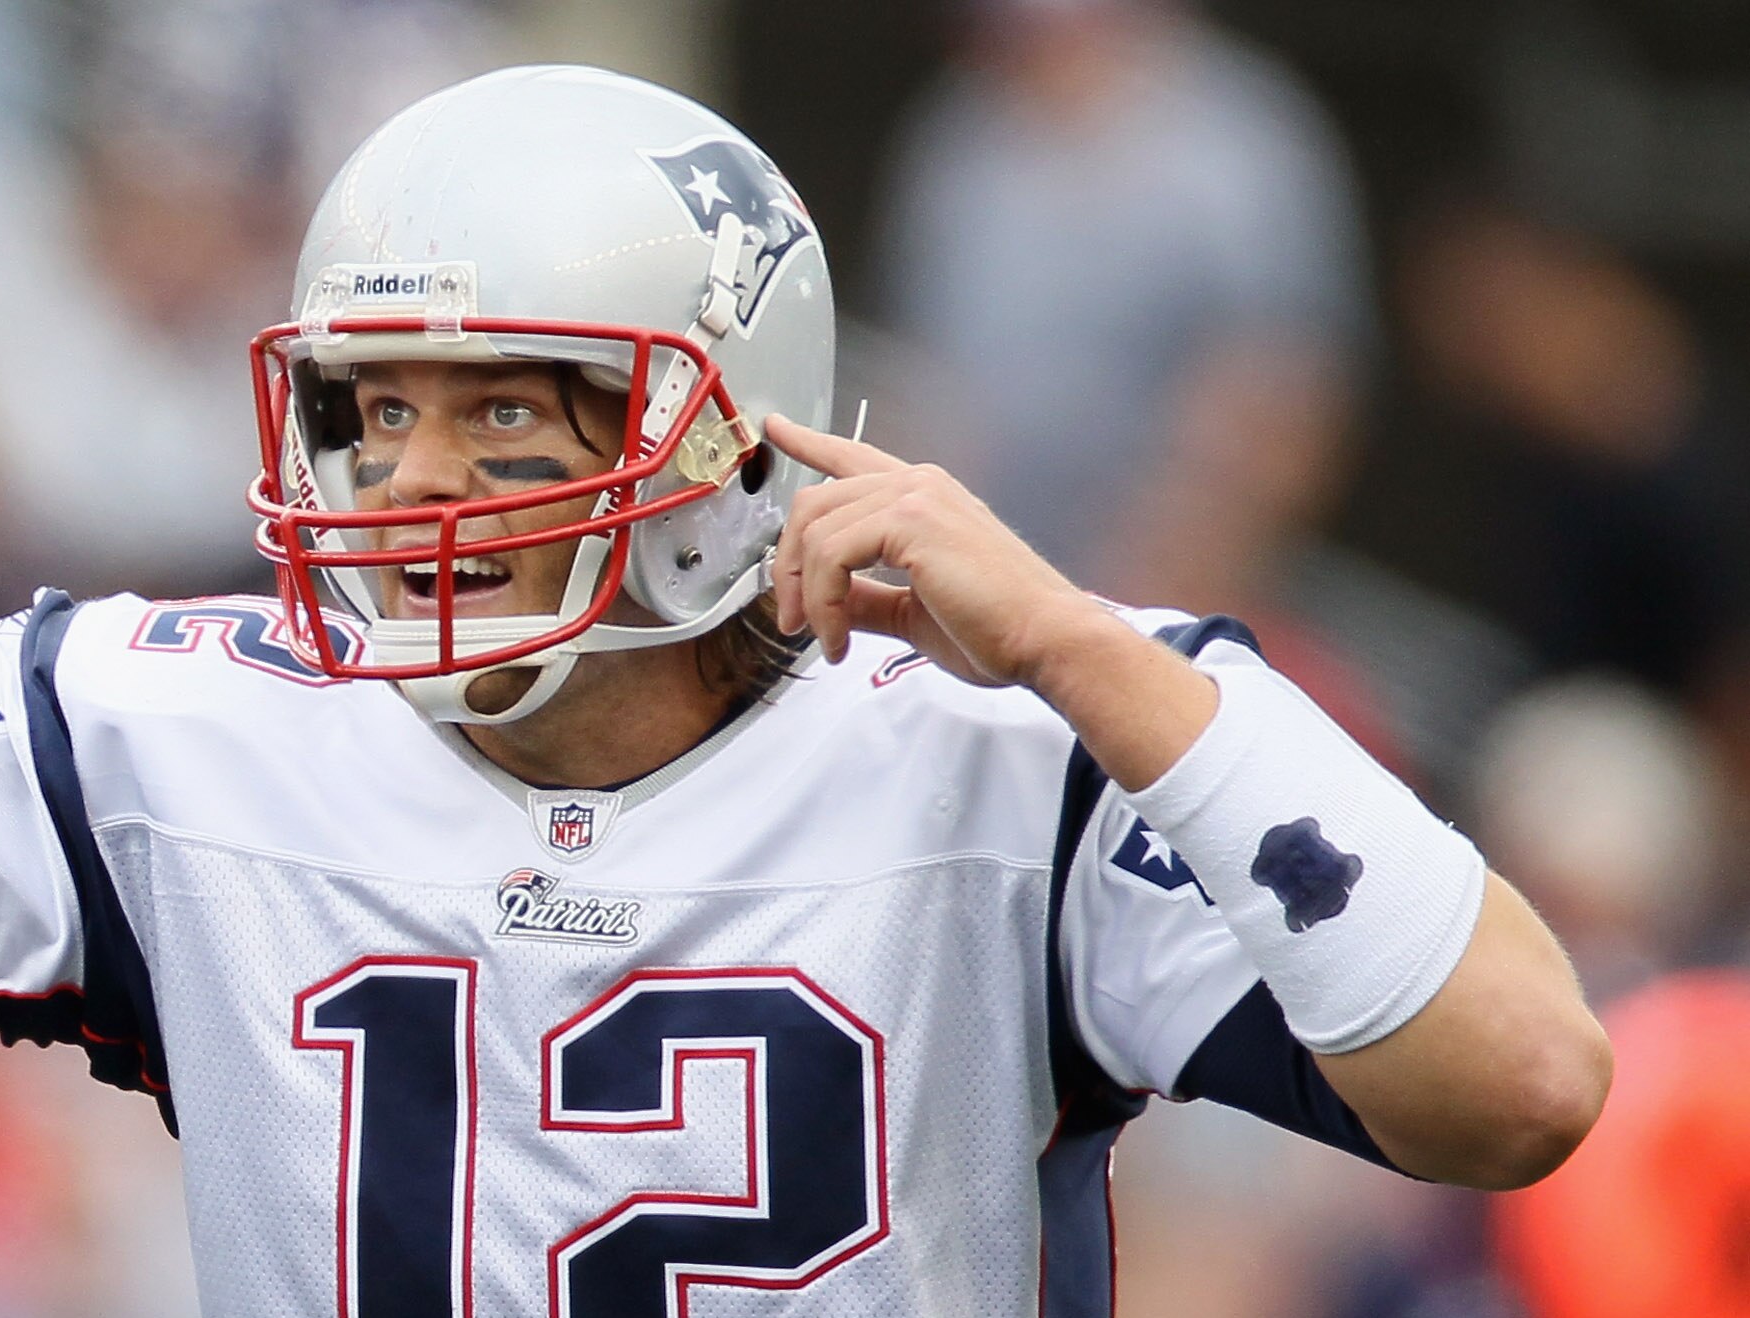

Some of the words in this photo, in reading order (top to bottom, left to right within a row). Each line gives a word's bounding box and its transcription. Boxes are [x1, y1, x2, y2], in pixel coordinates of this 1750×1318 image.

[353, 274, 433, 296] Riddell
[553, 820, 588, 848] NFL
[497, 886, 641, 943] Patriots
